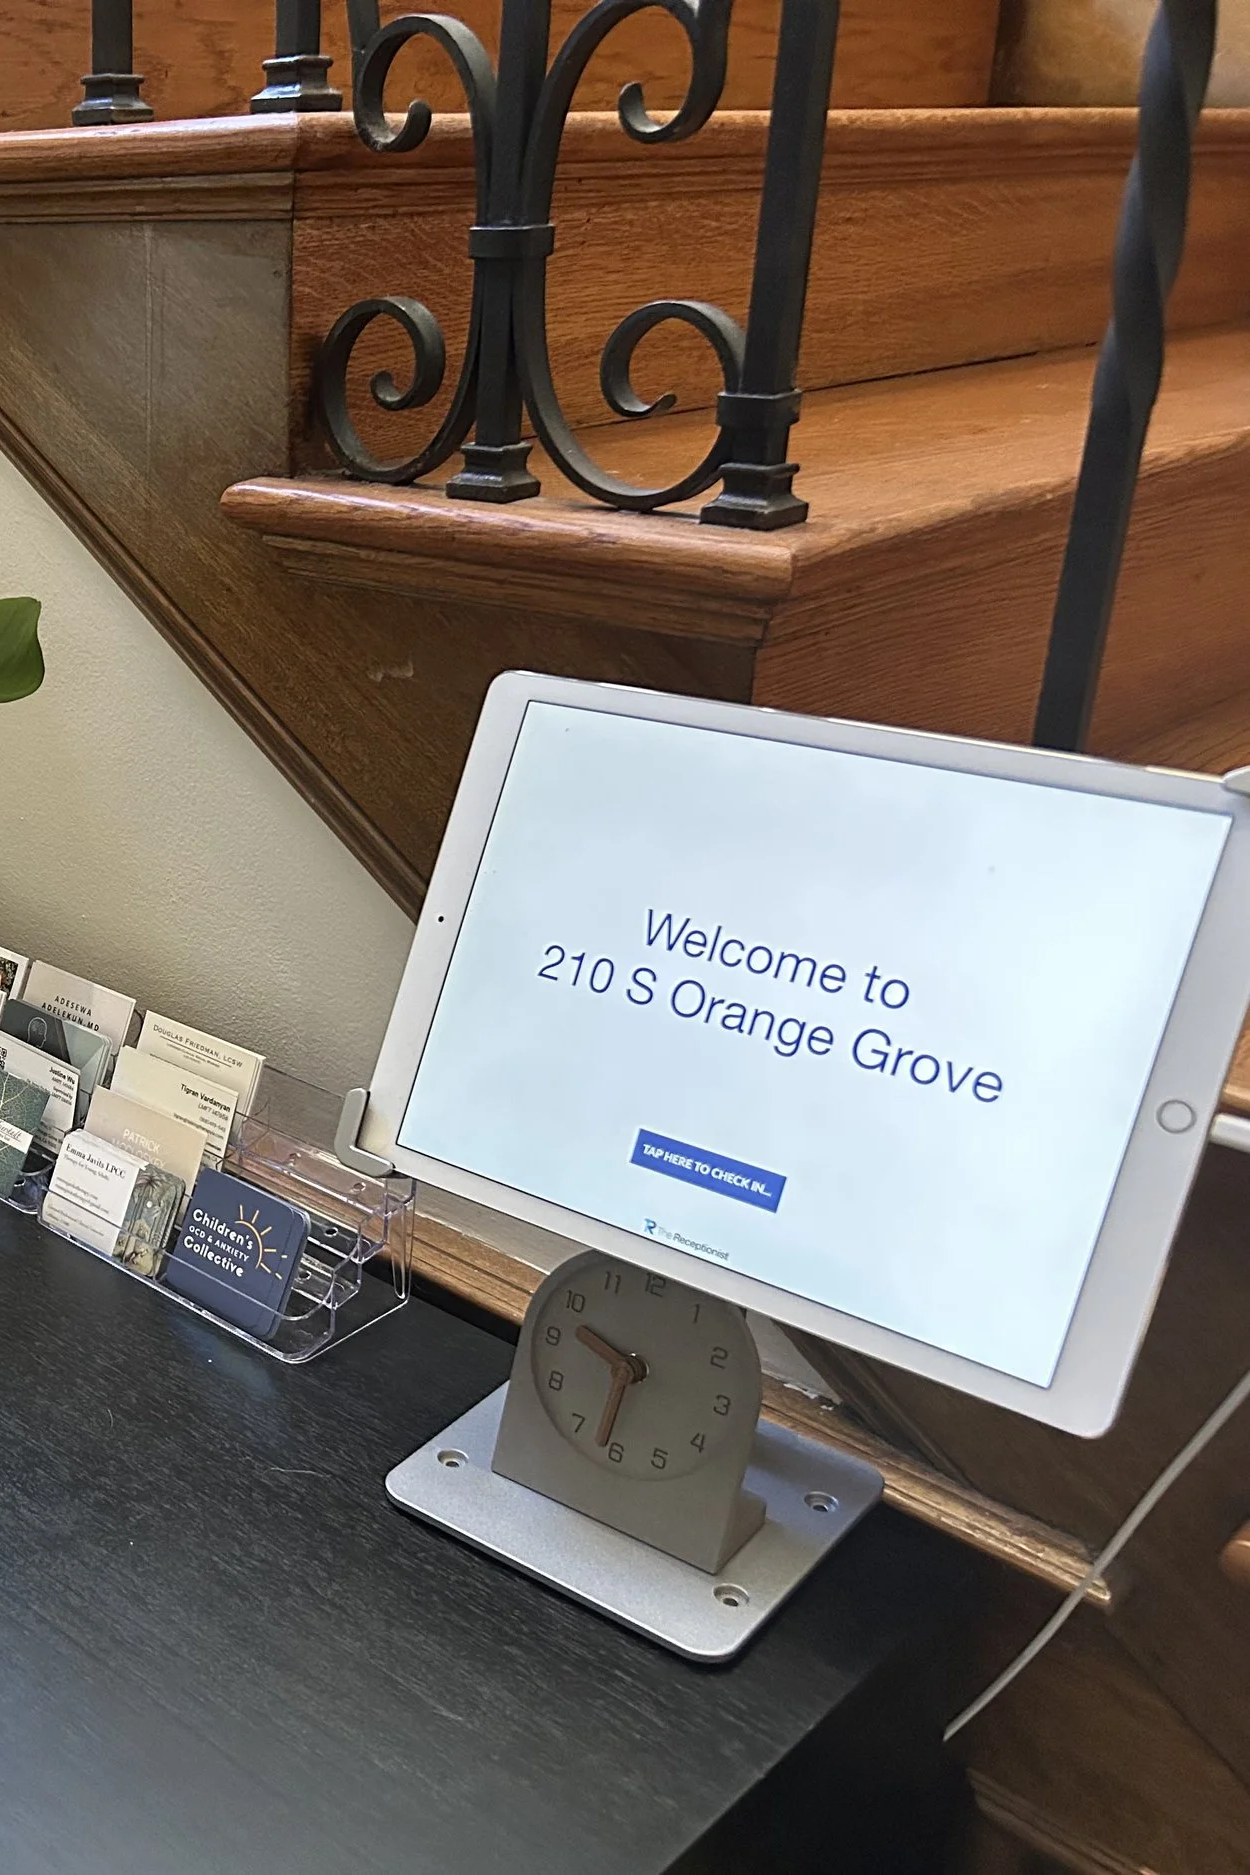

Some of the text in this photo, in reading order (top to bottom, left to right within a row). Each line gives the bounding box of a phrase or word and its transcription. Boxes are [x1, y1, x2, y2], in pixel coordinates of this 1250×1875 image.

[645, 908, 911, 1010] Welcome to
[54, 995, 92, 1017] ADESEWA
[538, 945, 1005, 1104] 210 S Orange Grove
[153, 1024, 183, 1043] DOUGLAS
[223, 1055, 243, 1068] LCSW
[181, 1083, 231, 1112] Tigran Vardanyan
[123, 1128, 160, 1154] PATRICK
[66, 1143, 86, 1160] Emma
[86, 1153, 104, 1170] Javits
[105, 1163, 127, 1179] LPCC
[642, 1143, 664, 1159] TAP
[663, 1151, 693, 1170] HERE
[694, 1161, 710, 1175] TO
[711, 1167, 750, 1190] CHECK
[192, 1208, 254, 1250] Children's
[188, 1225, 250, 1262] OCD & ANXIETY
[658, 1226, 673, 1239] The
[673, 1232, 730, 1261] Receptionist
[183, 1235, 244, 1278] Collective
[604, 1271, 622, 1294] 11
[644, 1272, 667, 1297] 12
[566, 1289, 586, 1313] 10
[692, 1304, 700, 1324] 1
[545, 1325, 561, 1346] 9
[710, 1346, 728, 1369] 2
[548, 1370, 564, 1391] 8
[713, 1394, 731, 1416] 3
[571, 1412, 585, 1433] 7
[608, 1442, 624, 1463] 6
[690, 1432, 705, 1453] 4
[650, 1447, 668, 1470] 5
